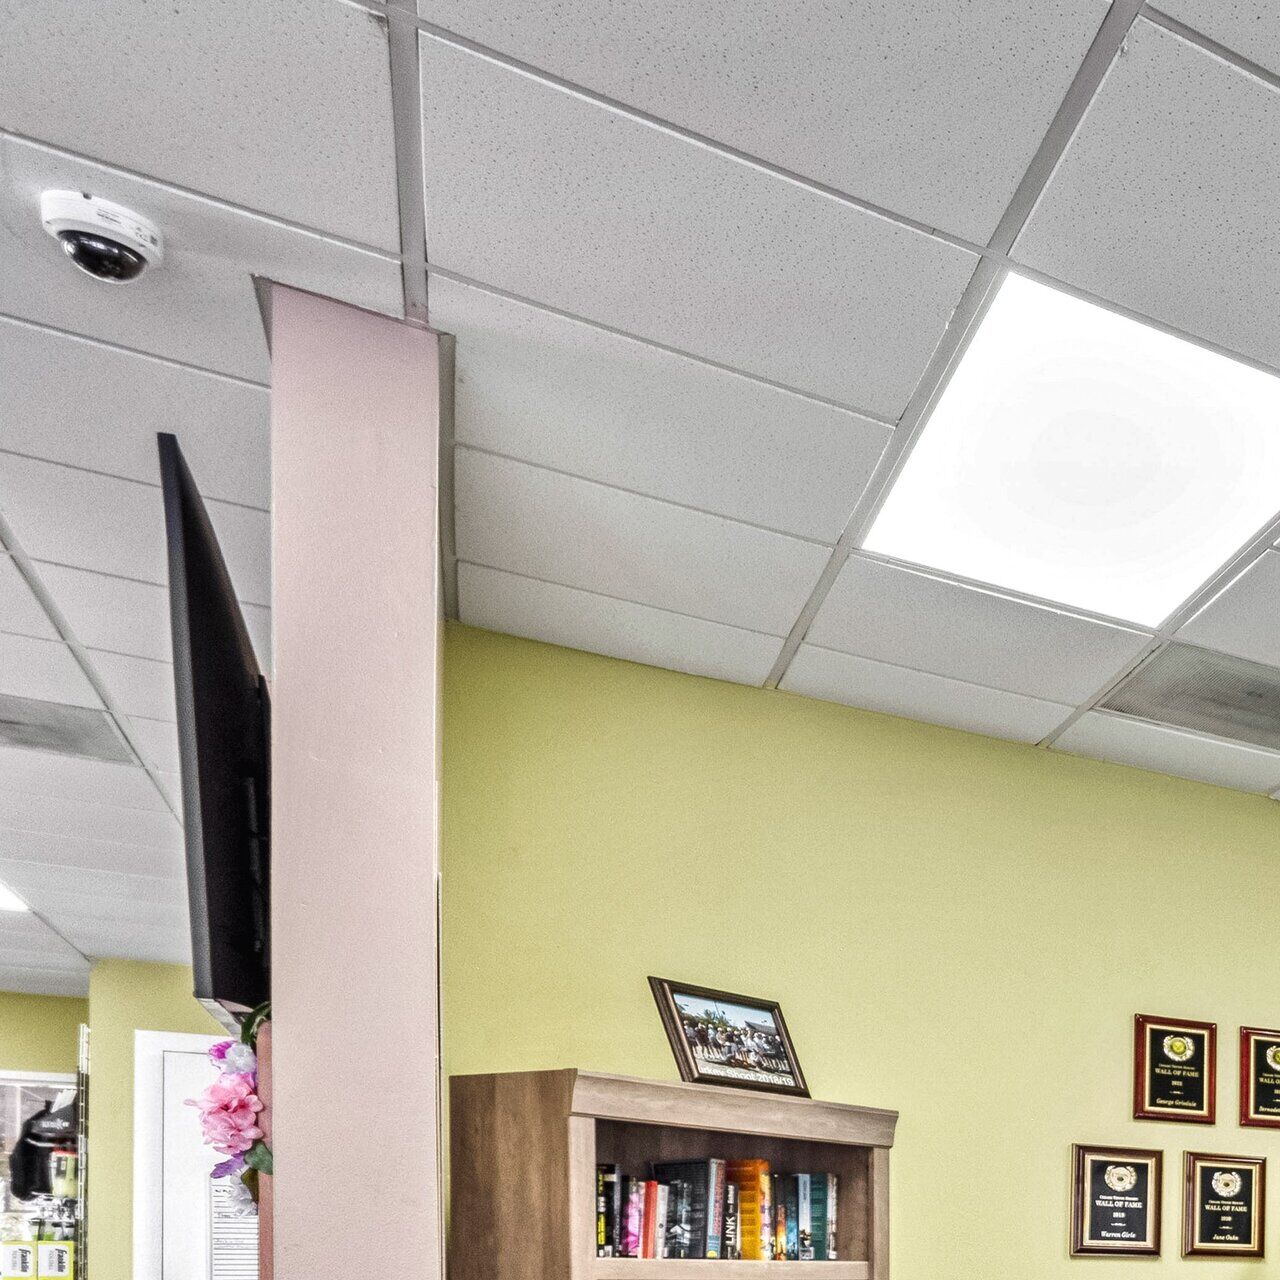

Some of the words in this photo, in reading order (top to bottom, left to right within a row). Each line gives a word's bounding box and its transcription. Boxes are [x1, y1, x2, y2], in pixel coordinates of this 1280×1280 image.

[1155, 1067, 1172, 1075] WALL
[1114, 1200, 1124, 1208] OF
[1124, 1201, 1143, 1209] FAME
[725, 1216, 737, 1246] LINK
[1101, 1230, 1121, 1238] Warren
[18, 1248, 31, 1273] franklin
[55, 1248, 67, 1273] franklin
